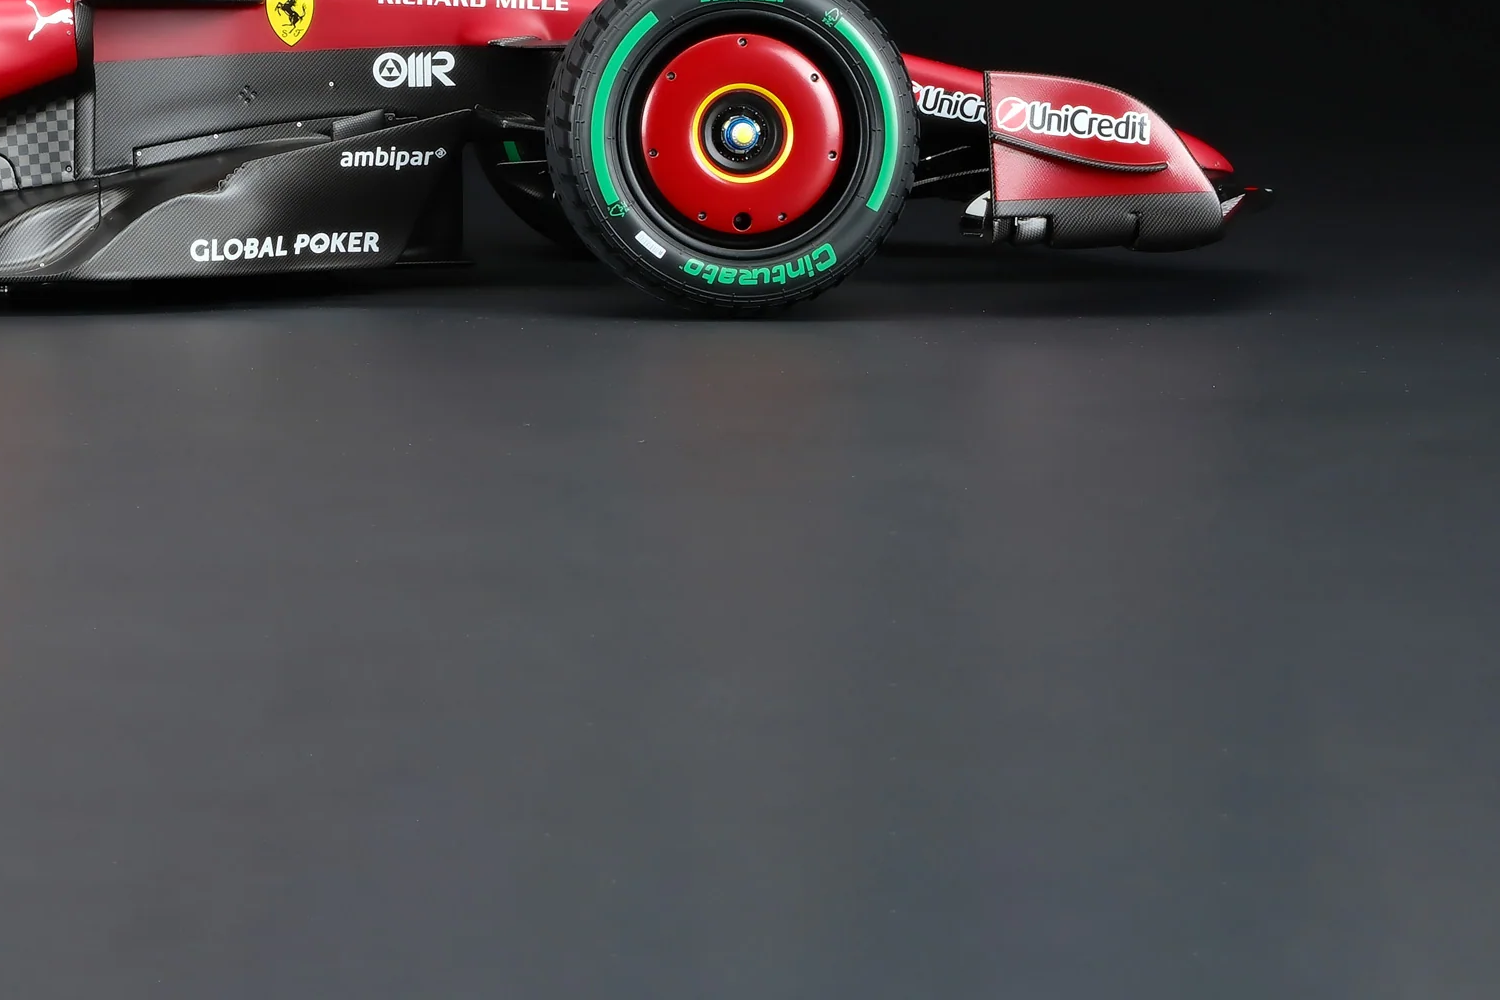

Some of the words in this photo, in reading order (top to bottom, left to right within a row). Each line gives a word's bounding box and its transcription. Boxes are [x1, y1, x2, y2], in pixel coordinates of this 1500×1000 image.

[921, 87, 987, 122] UniCr
[1029, 104, 1148, 142] UniCredit
[340, 146, 434, 170] ambipar
[190, 235, 288, 262] GLOBAL
[293, 231, 380, 255] POKER
